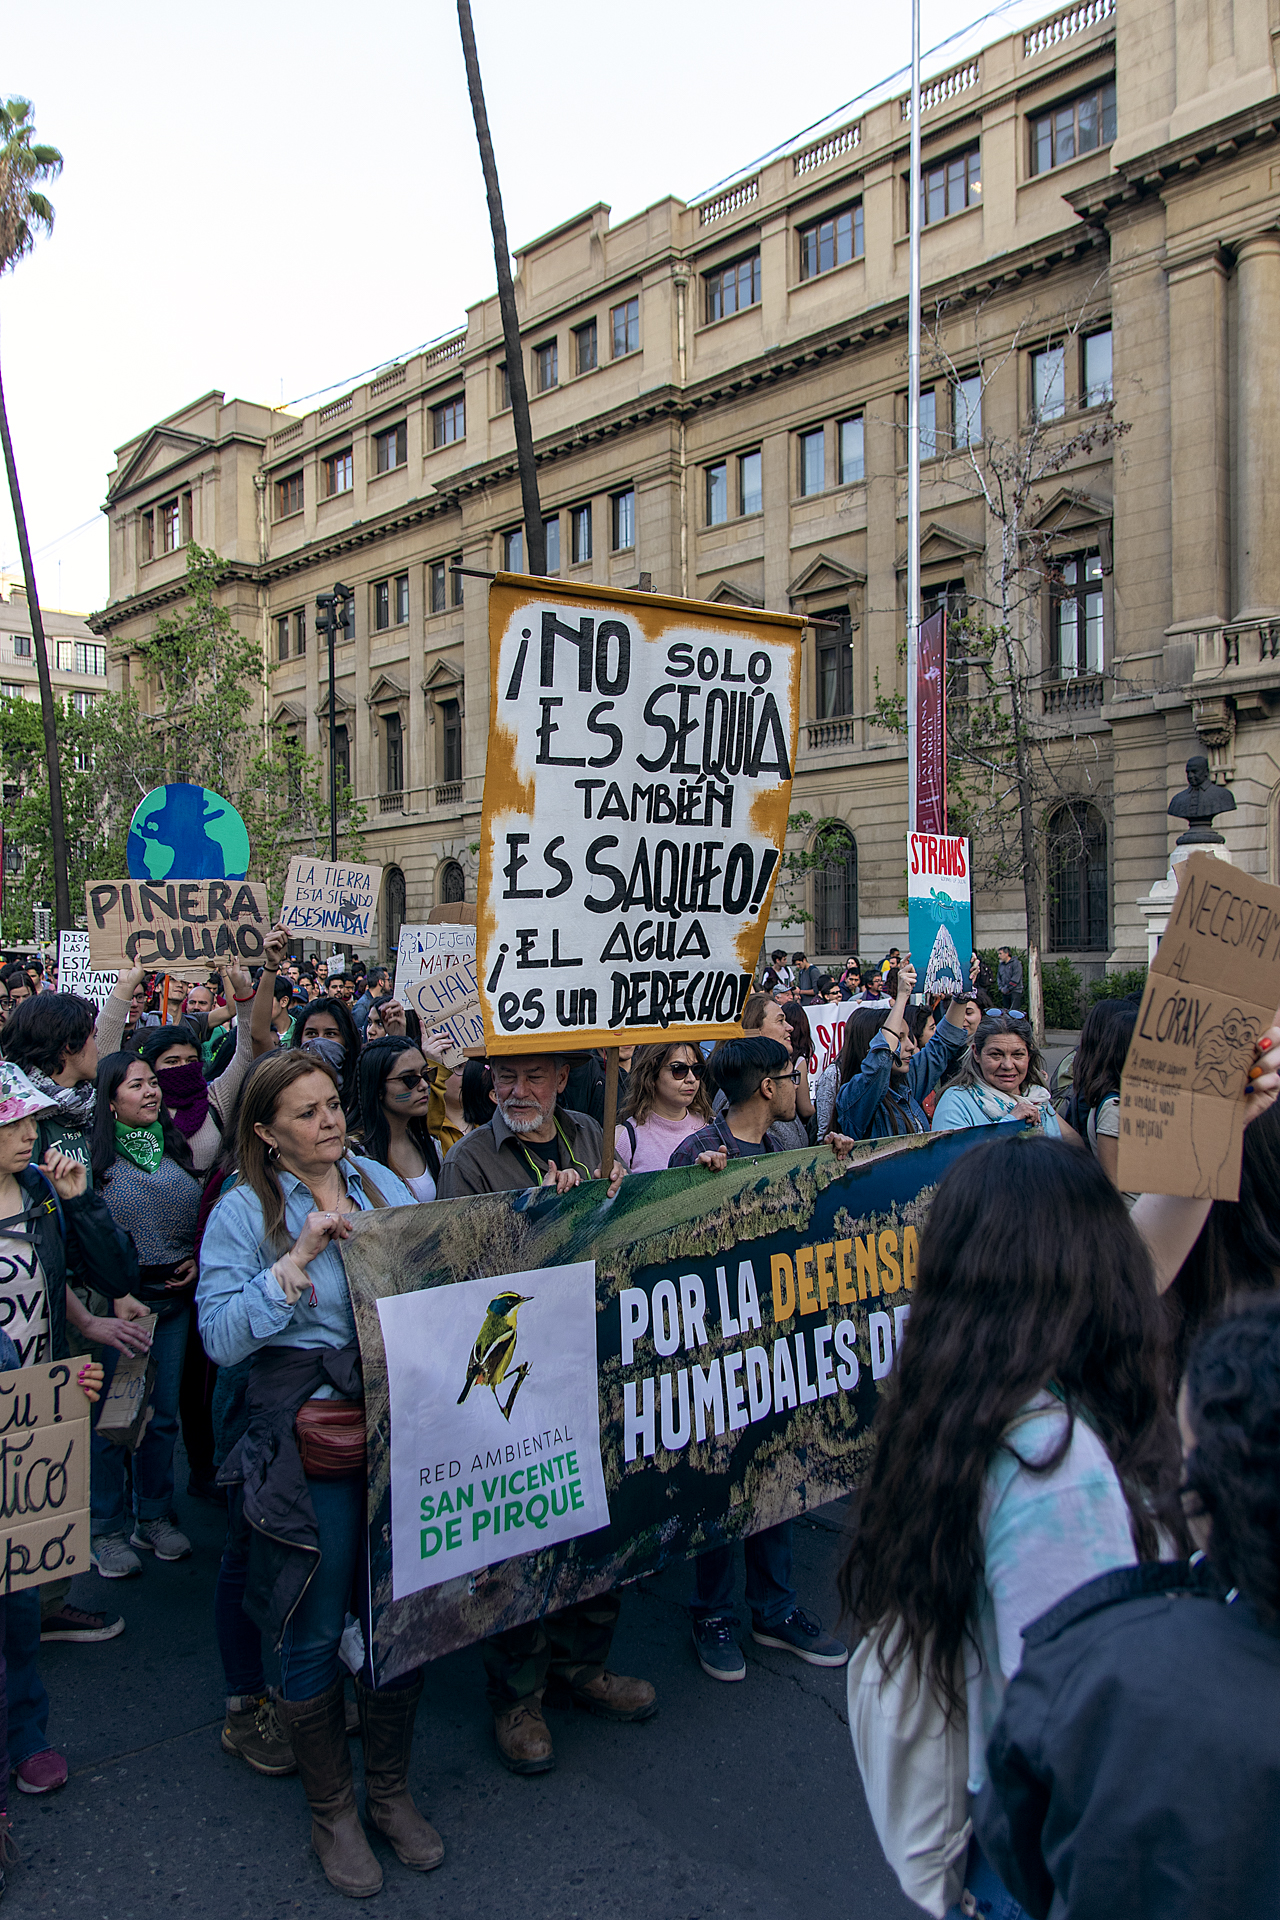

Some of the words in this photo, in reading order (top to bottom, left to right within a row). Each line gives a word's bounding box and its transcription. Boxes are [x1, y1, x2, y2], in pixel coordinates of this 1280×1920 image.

[505, 610, 631, 700] ¡NO
[665, 642, 772, 684] SOLO
[536, 697, 623, 768] ES
[636, 683, 792, 785] SEQUÍA
[574, 773, 734, 828] TAMBIÉN
[296, 865, 315, 886] LA
[324, 867, 370, 890] TIERRA
[502, 833, 573, 899] ES
[584, 835, 780, 919] SAQUEO!
[911, 833, 966, 877] STRAWS
[326, 889, 374, 908] SIENDO
[63, 944, 81, 953] LAS
[600, 919, 710, 964] AGUA
[1166, 942, 1190, 984] AL
[84, 984, 115, 995] SALV
[498, 987, 546, 1032] es
[556, 987, 597, 1026] un
[608, 970, 752, 1029] DERECHO!
[125, 1130, 142, 1140] FOR
[142, 1130, 161, 1153] FUTURE
[619, 1273, 708, 1366] POR
[716, 1259, 762, 1339] LA
[770, 1225, 921, 1322] DEFENSA
[623, 1319, 860, 1463] HUMEDALES
[420, 1460, 461, 1486] RED
[471, 1425, 573, 1473] AMBIENTAL
[420, 1483, 474, 1522] SAN
[481, 1449, 579, 1503] VICENTE
[420, 1517, 462, 1560] DE
[472, 1478, 585, 1543] PIRQUE
